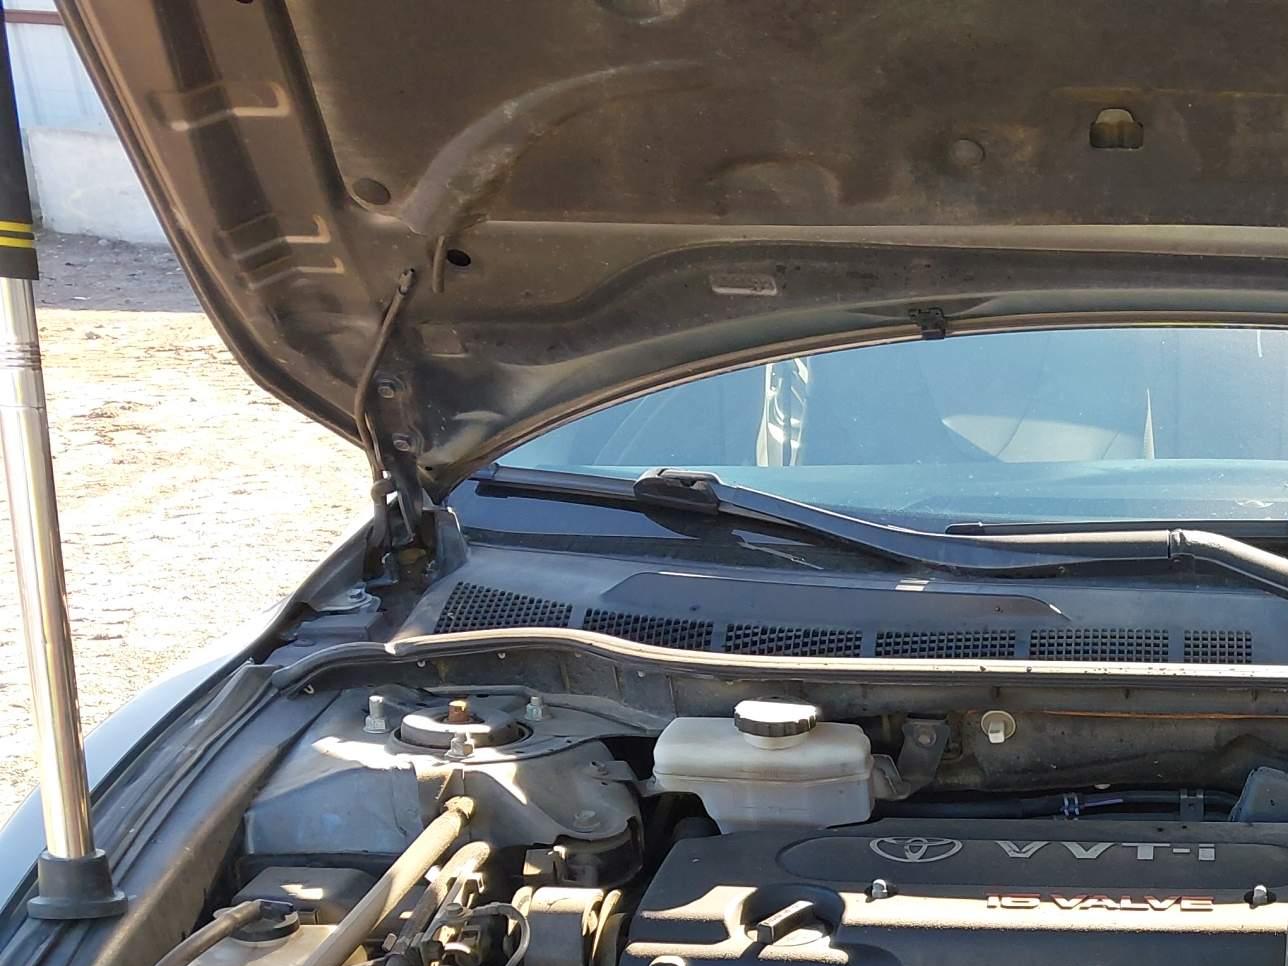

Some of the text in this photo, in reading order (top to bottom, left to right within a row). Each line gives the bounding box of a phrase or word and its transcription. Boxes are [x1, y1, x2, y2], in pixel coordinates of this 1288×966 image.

[995, 839, 1216, 862] VVT-i
[985, 892, 1215, 913] 16 VALVE
